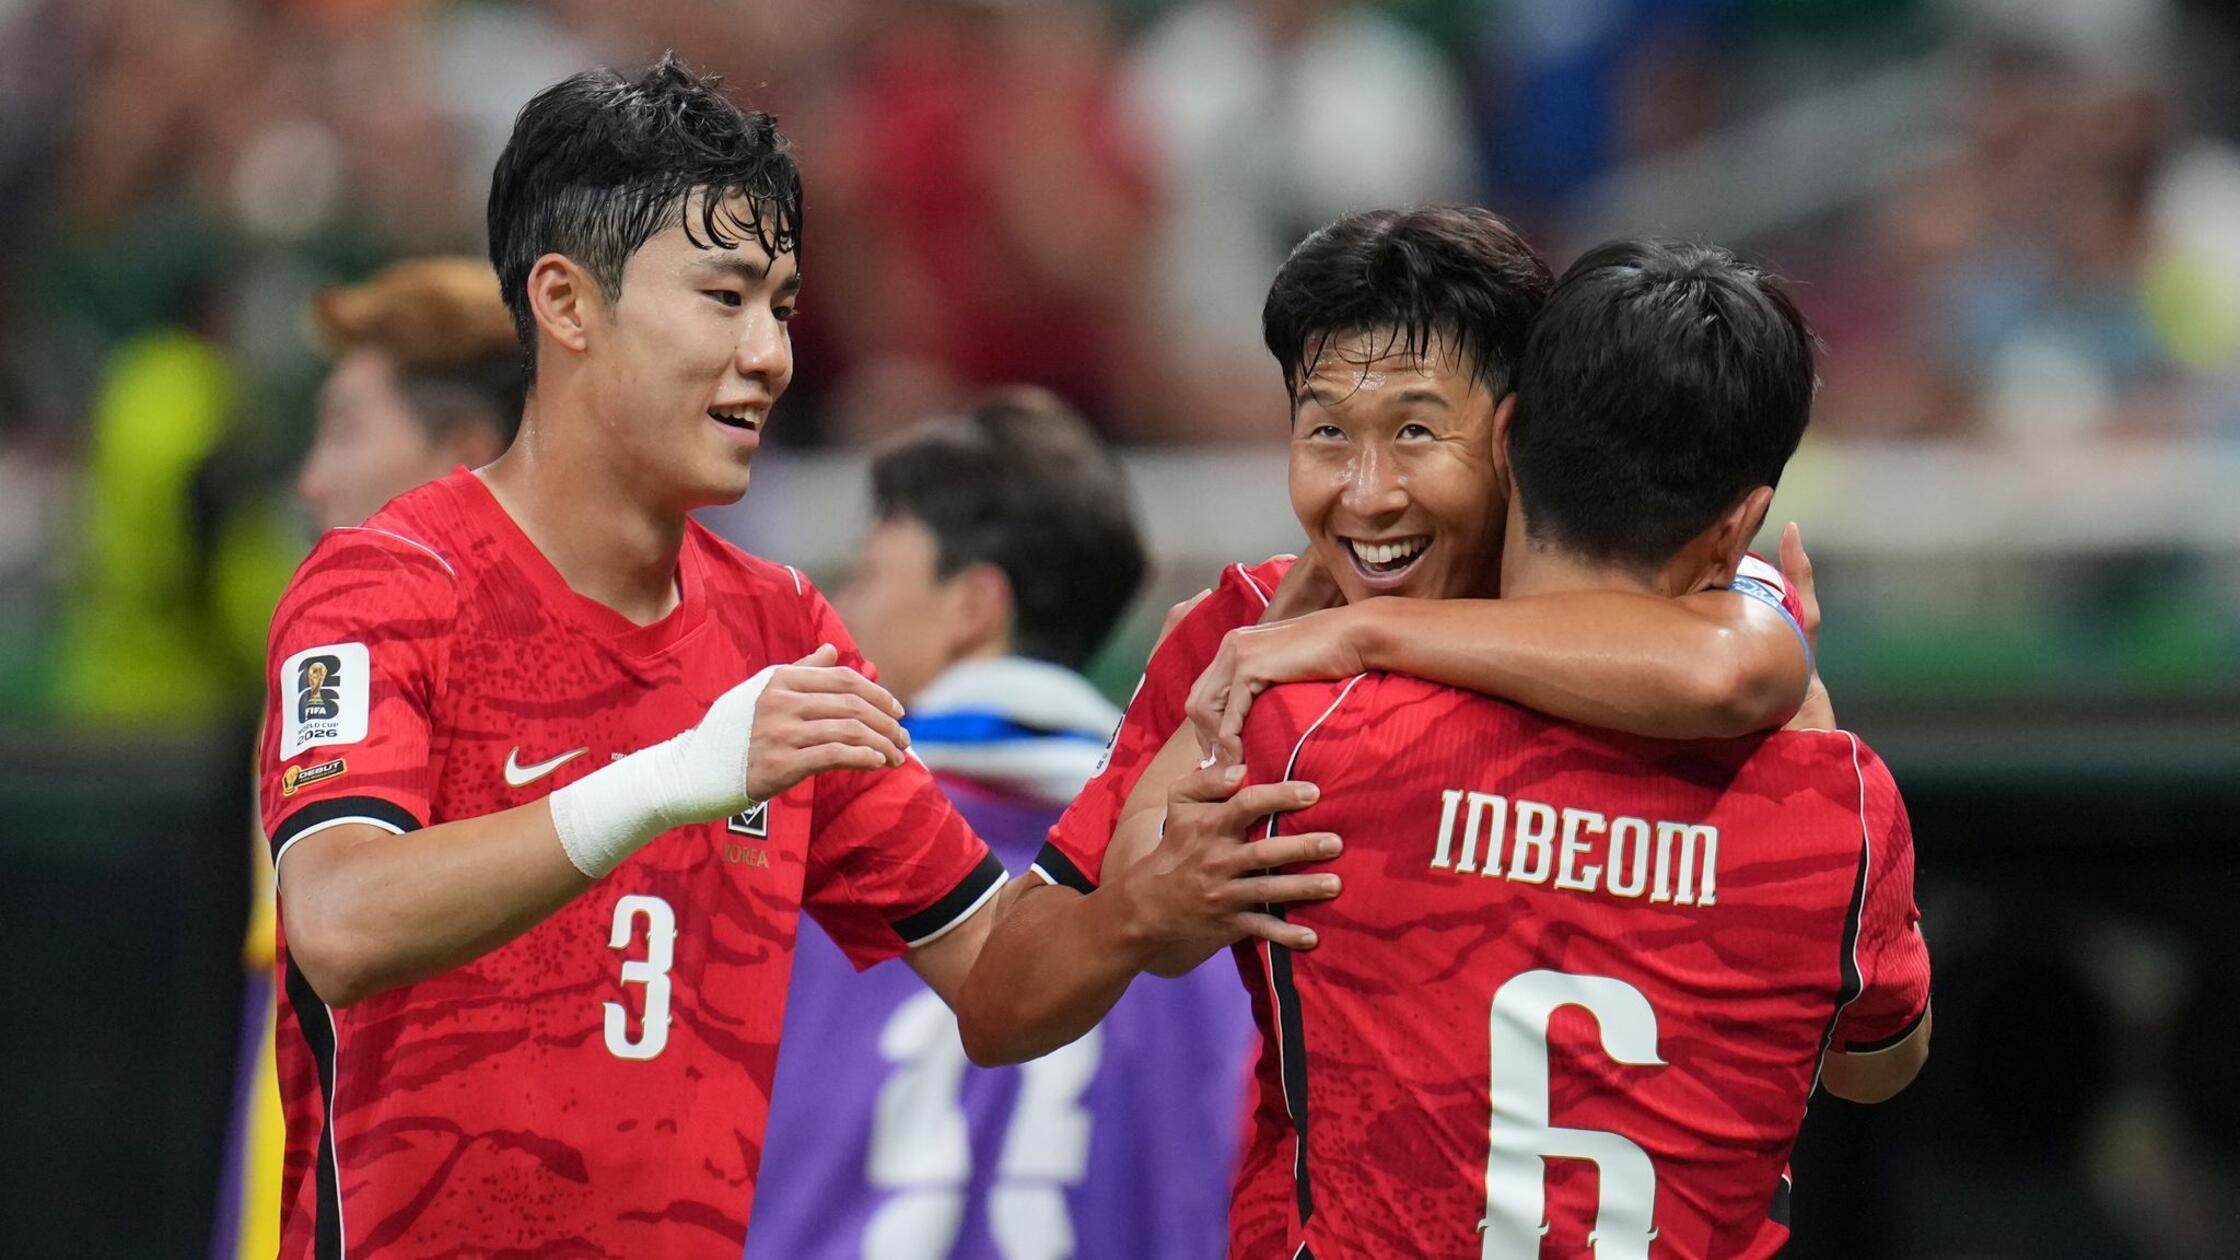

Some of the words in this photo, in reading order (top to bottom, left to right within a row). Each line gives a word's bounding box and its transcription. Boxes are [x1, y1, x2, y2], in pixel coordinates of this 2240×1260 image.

[305, 706, 327, 720] FIFA
[297, 729, 338, 746] 2026
[298, 761, 341, 779] DEBUT
[723, 844, 769, 869] KOREA
[1430, 789, 1719, 907] INBEOM
[603, 894, 677, 1061] 3
[1477, 968, 1669, 1260] 6
